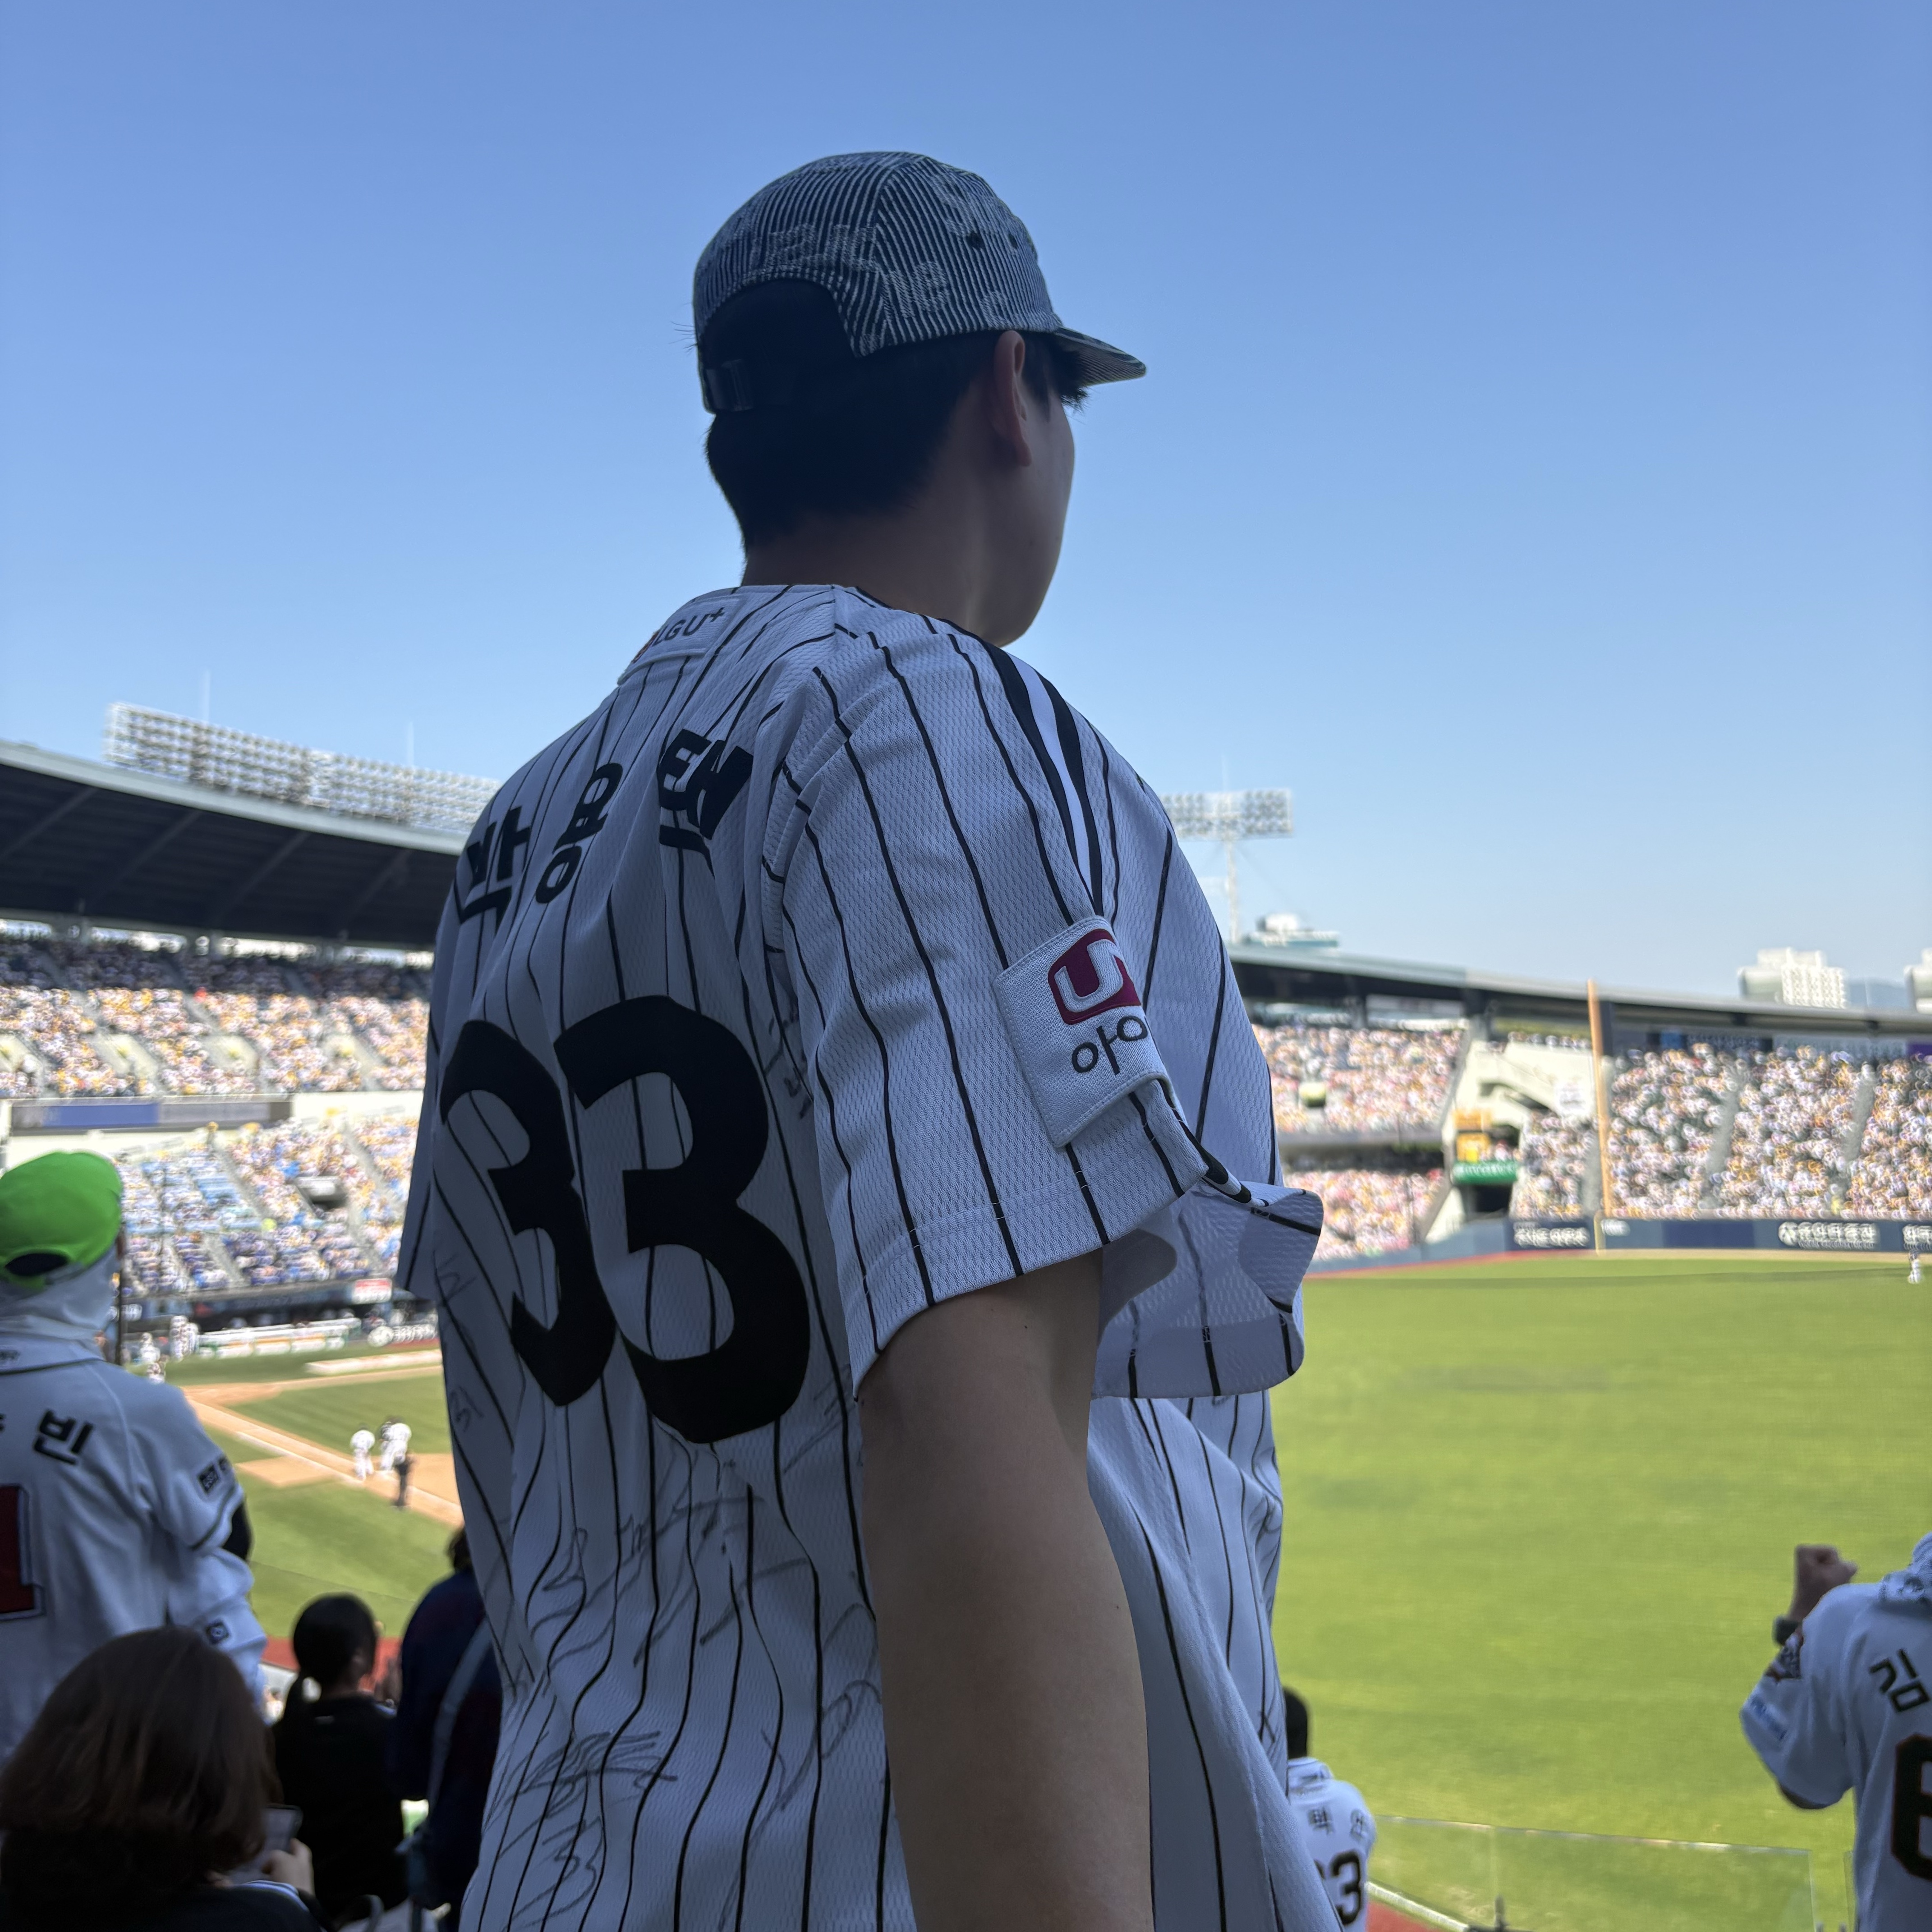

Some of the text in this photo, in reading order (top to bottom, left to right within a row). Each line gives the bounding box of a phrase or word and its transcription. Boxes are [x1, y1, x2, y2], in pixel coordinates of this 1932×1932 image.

[440, 995, 810, 1443] 33
[0, 1408, 94, 1465] 빈
[1870, 1648, 1931, 1712] 김
